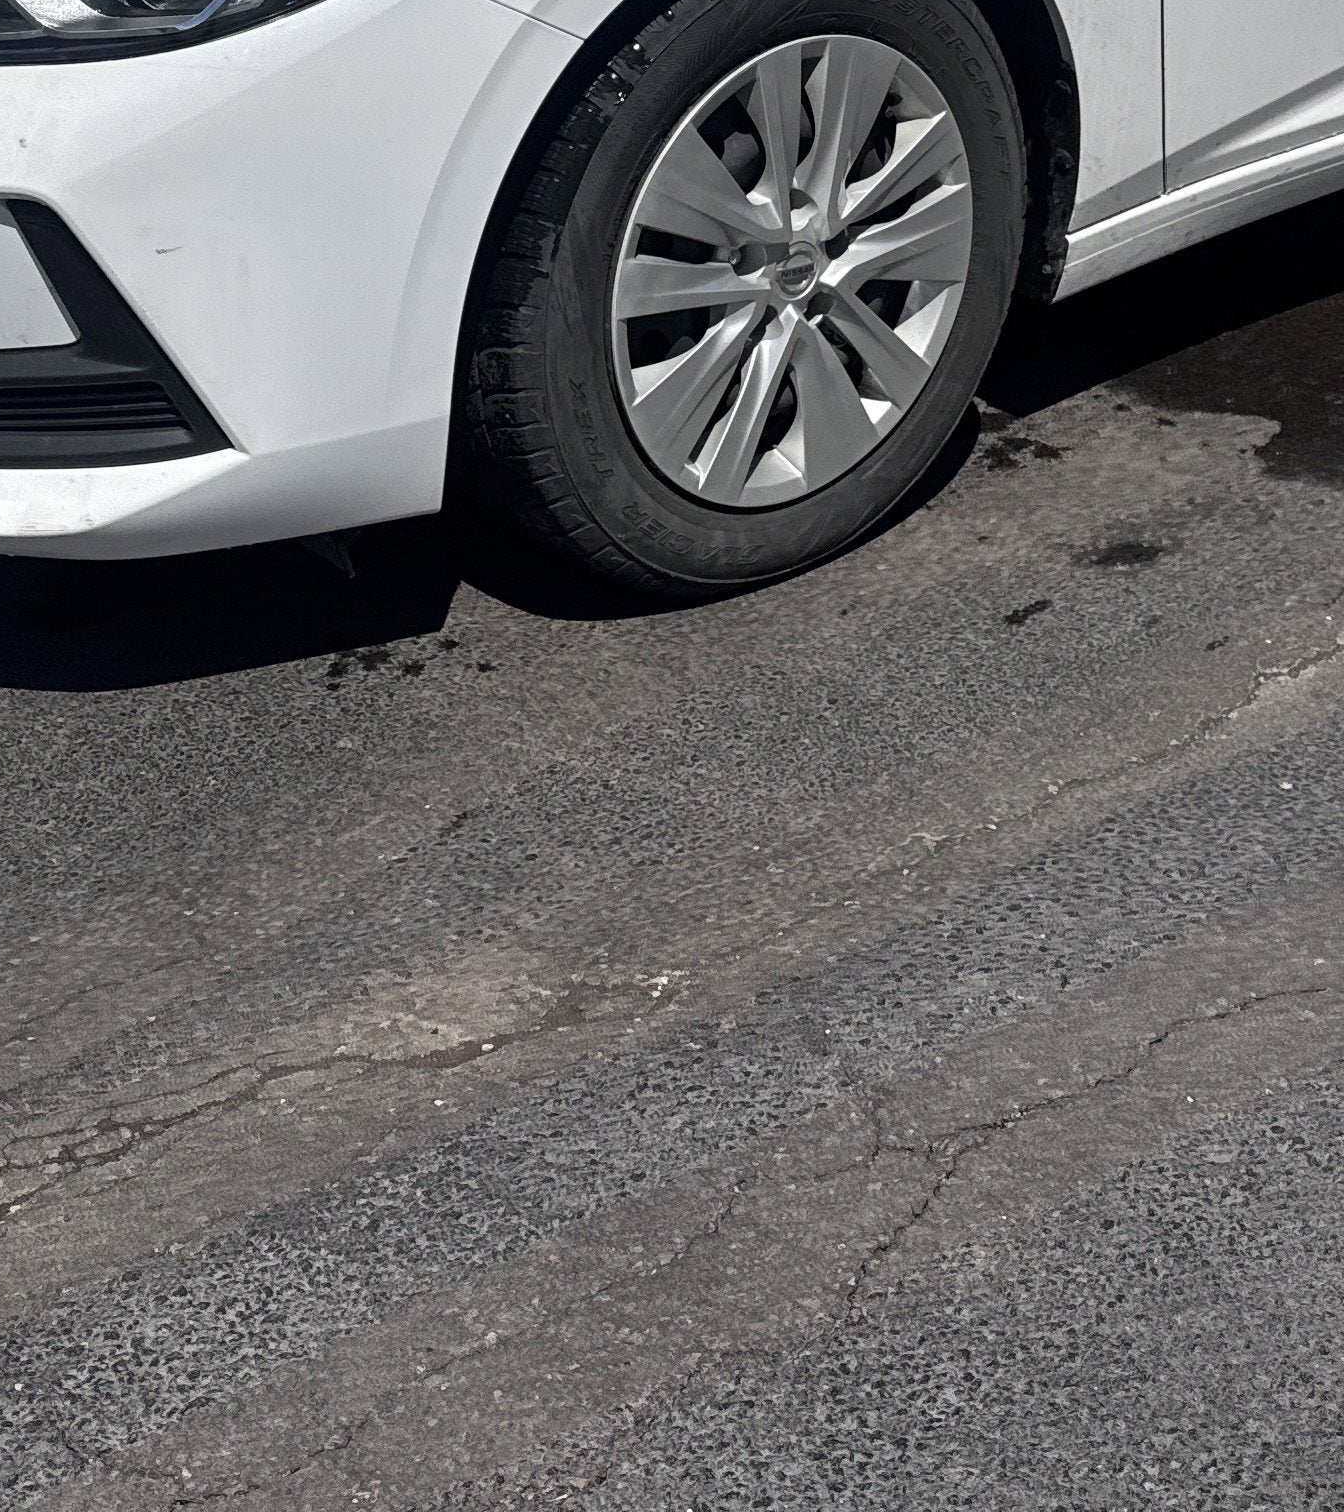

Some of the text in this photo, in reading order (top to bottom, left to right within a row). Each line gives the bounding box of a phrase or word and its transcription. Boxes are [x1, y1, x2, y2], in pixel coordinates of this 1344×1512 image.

[780, 263, 815, 278] NISSAN
[568, 378, 764, 566] GLACIER TREX
